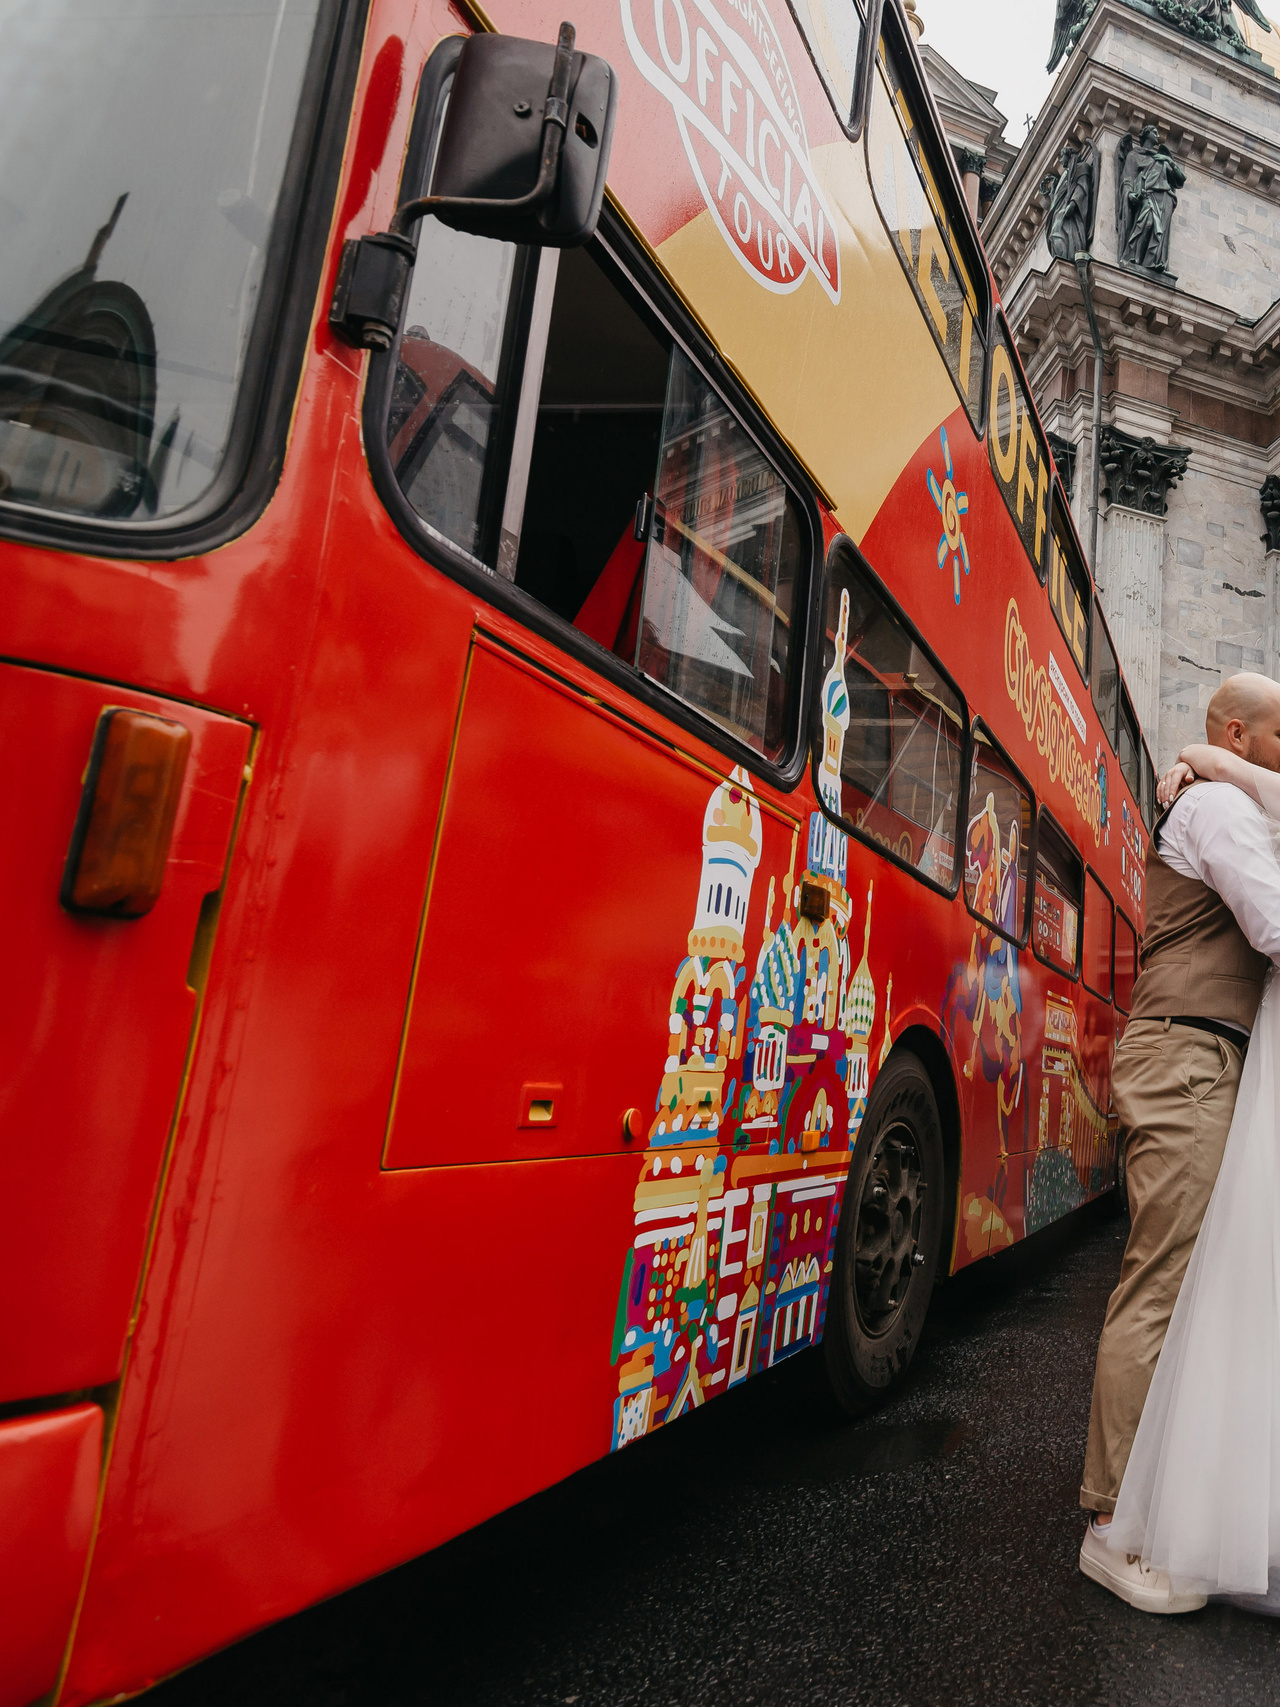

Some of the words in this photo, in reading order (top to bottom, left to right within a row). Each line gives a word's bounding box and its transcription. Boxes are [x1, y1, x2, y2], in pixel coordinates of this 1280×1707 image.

[654, 0, 831, 278] OFFICIAL
[718, 155, 794, 277] TOUR
[990, 345, 1084, 668] OFFICE
